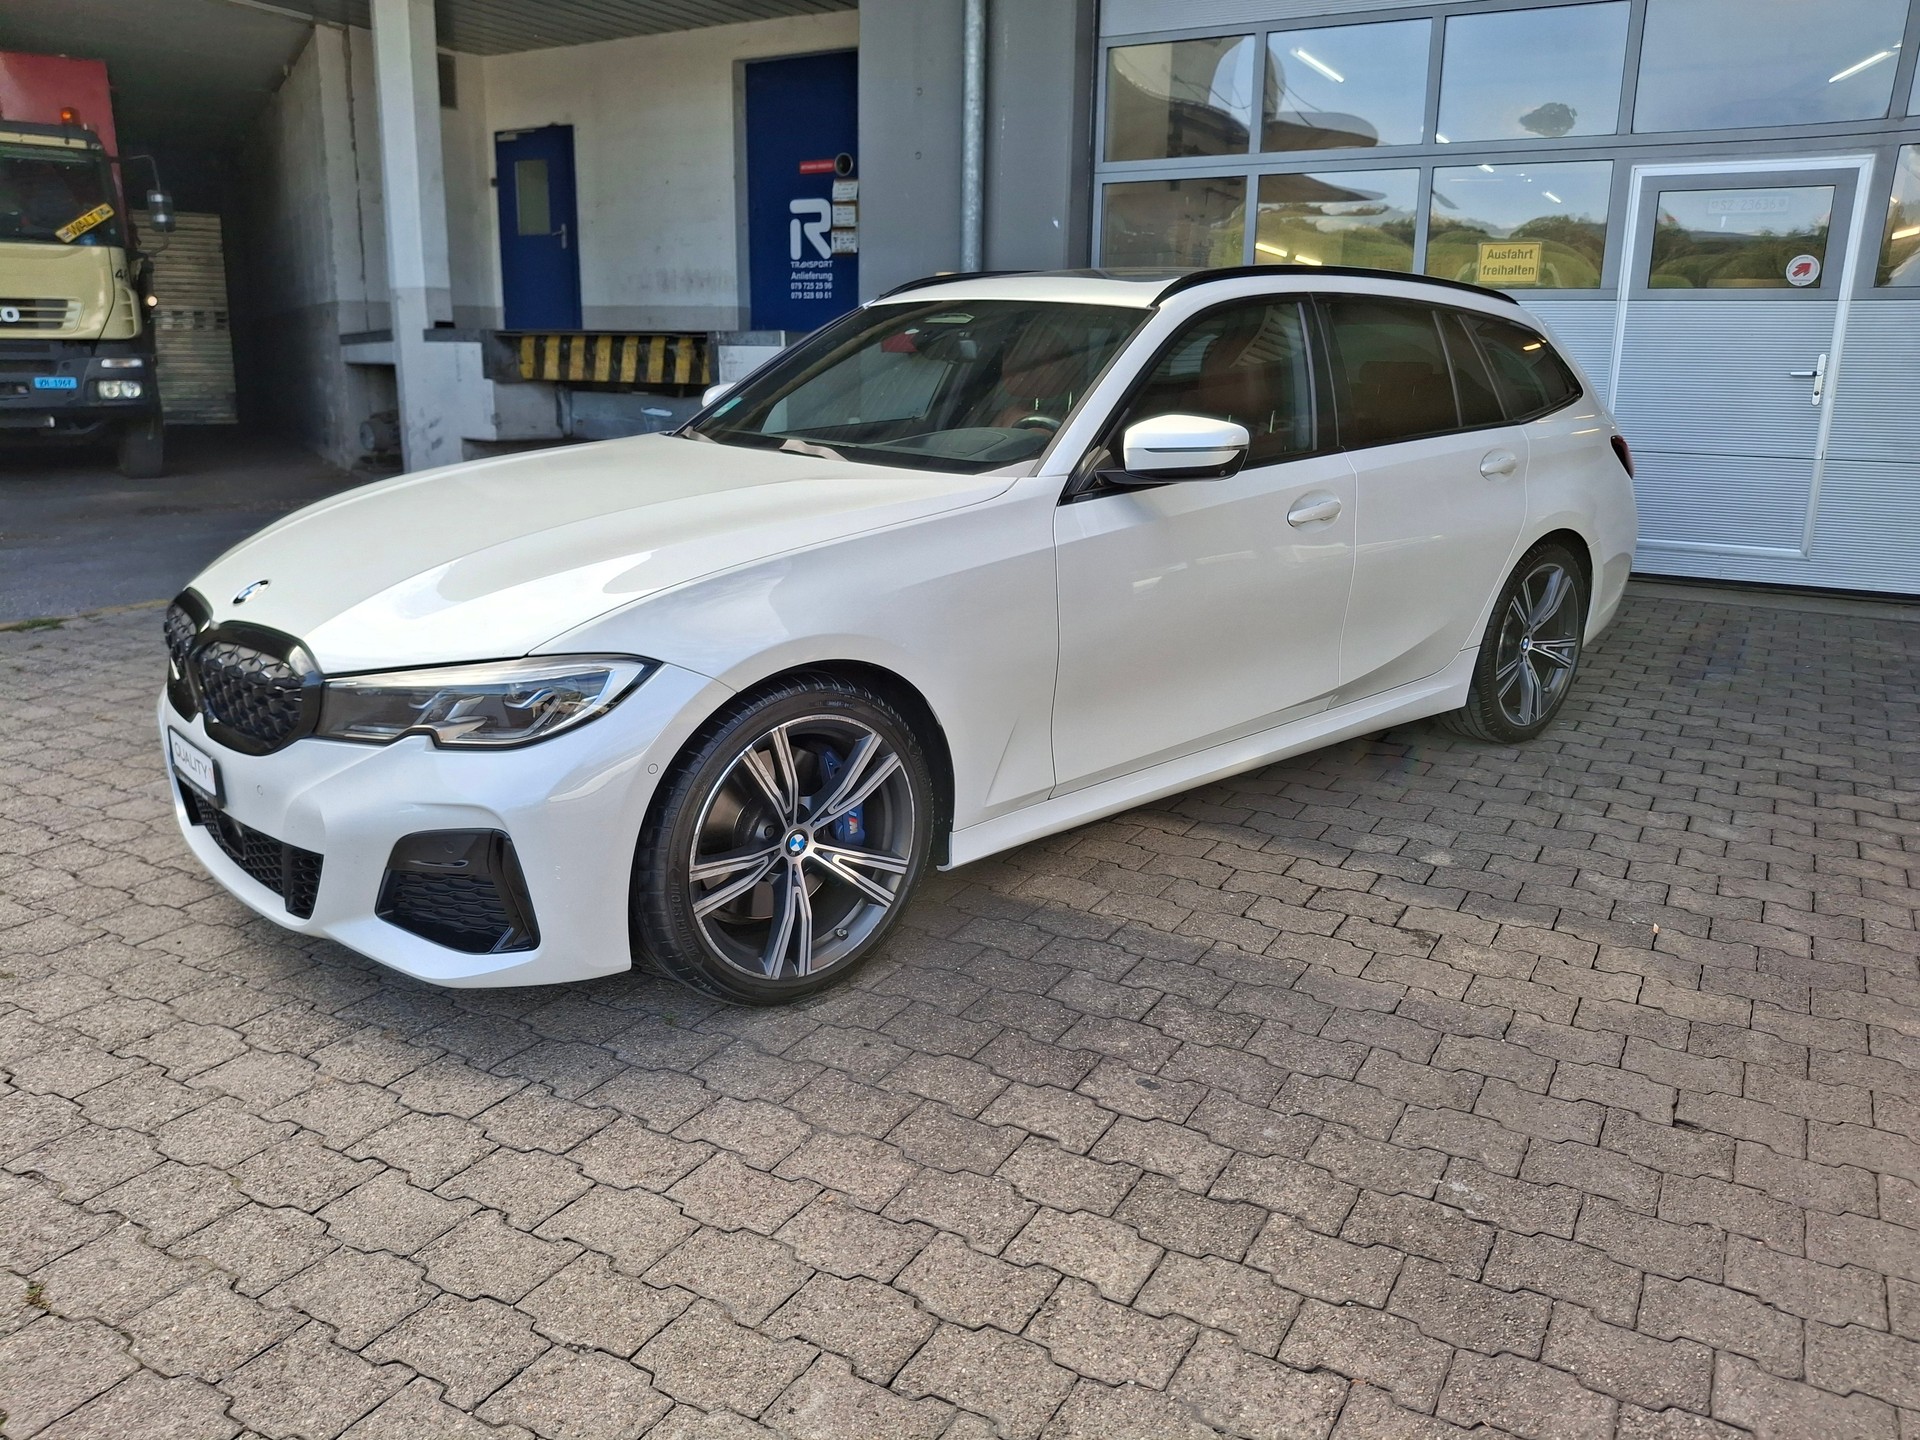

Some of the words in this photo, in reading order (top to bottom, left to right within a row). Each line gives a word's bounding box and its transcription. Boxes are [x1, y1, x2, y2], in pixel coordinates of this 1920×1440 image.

[1487, 249, 1533, 259] Ausfahrt
[1482, 265, 1535, 275] freihalten
[791, 271, 833, 281] Anlieferung
